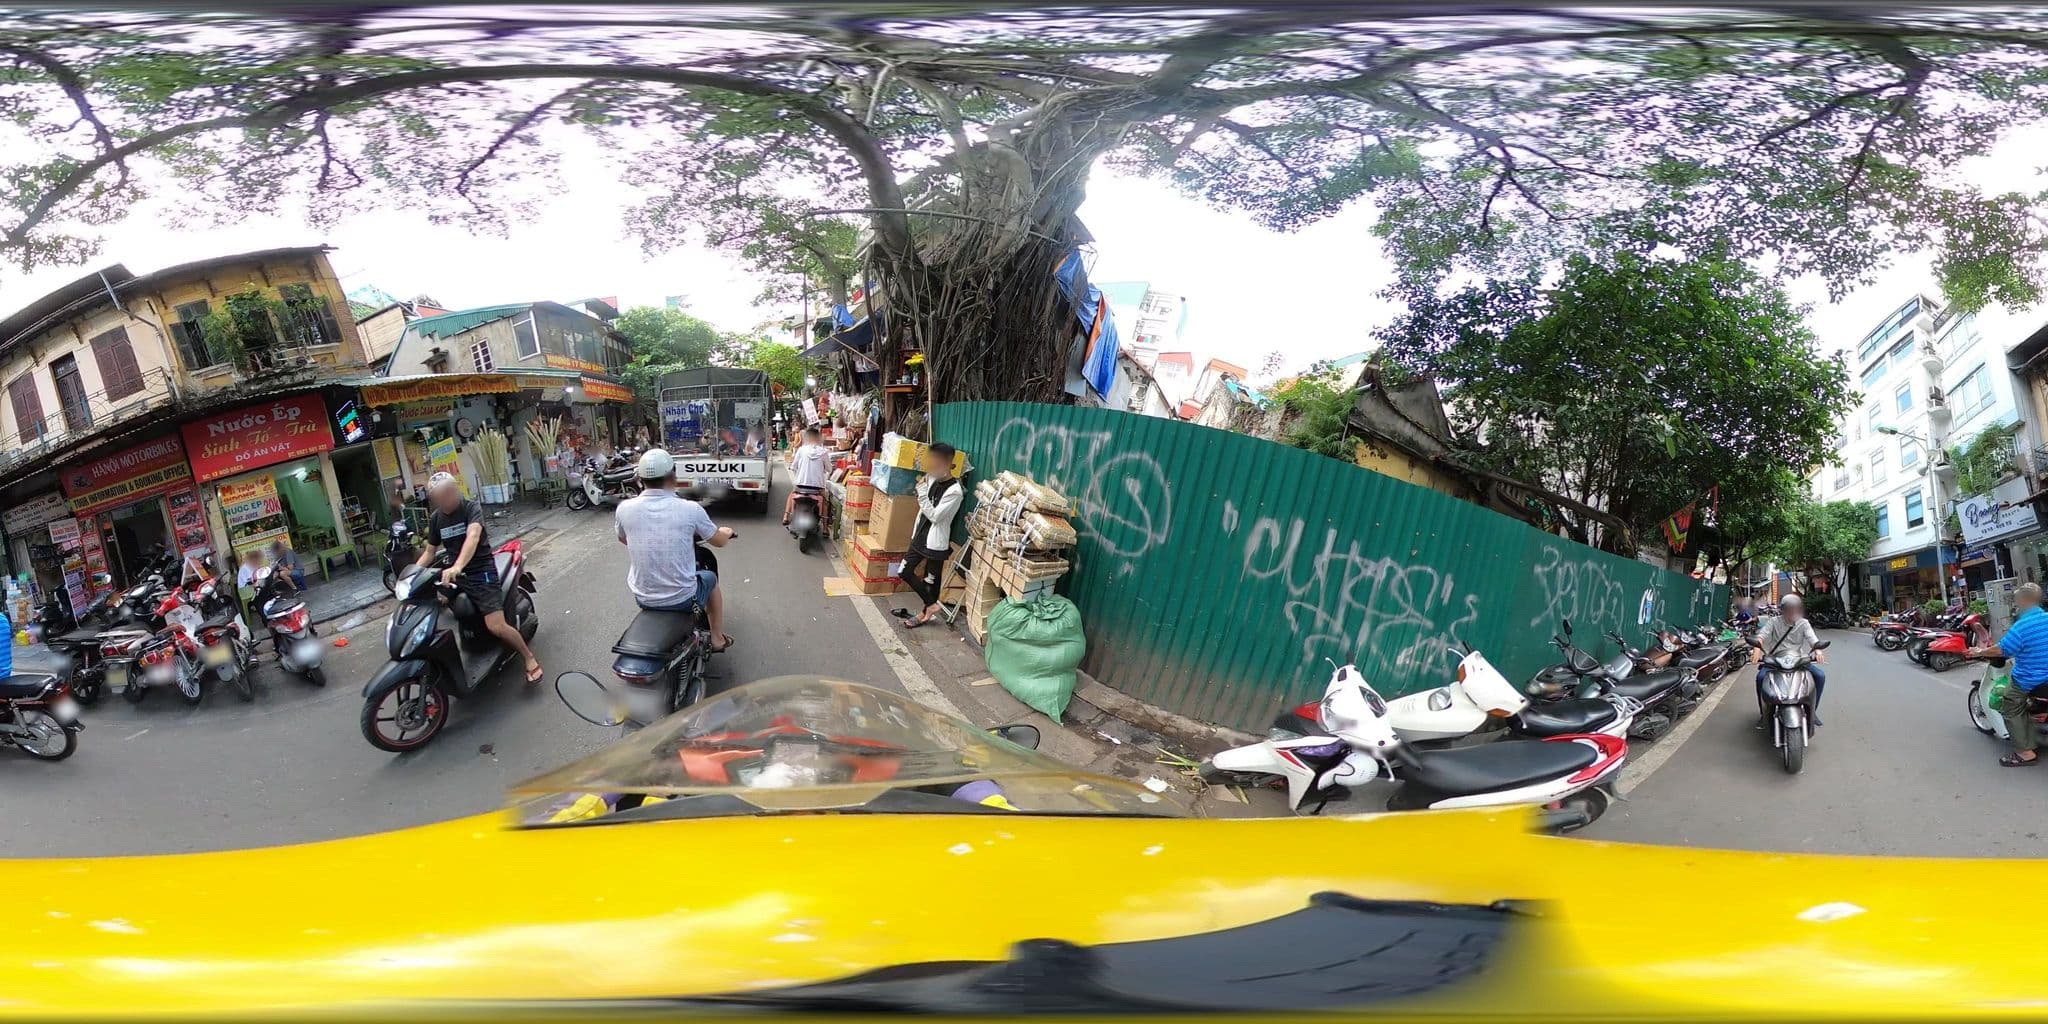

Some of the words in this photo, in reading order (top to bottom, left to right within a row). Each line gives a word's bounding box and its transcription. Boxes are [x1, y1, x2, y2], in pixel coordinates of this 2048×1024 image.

[207, 414, 266, 437] Nước
[271, 403, 301, 421] Ép
[120, 440, 179, 468] MOTORBIKES
[201, 436, 240, 459] Sinh
[685, 464, 745, 472] SUZUKI
[90, 482, 128, 504] INFORMATION
[129, 482, 134, 491] &
[134, 472, 164, 489] BOOKING
[164, 464, 187, 480] OFFICE
